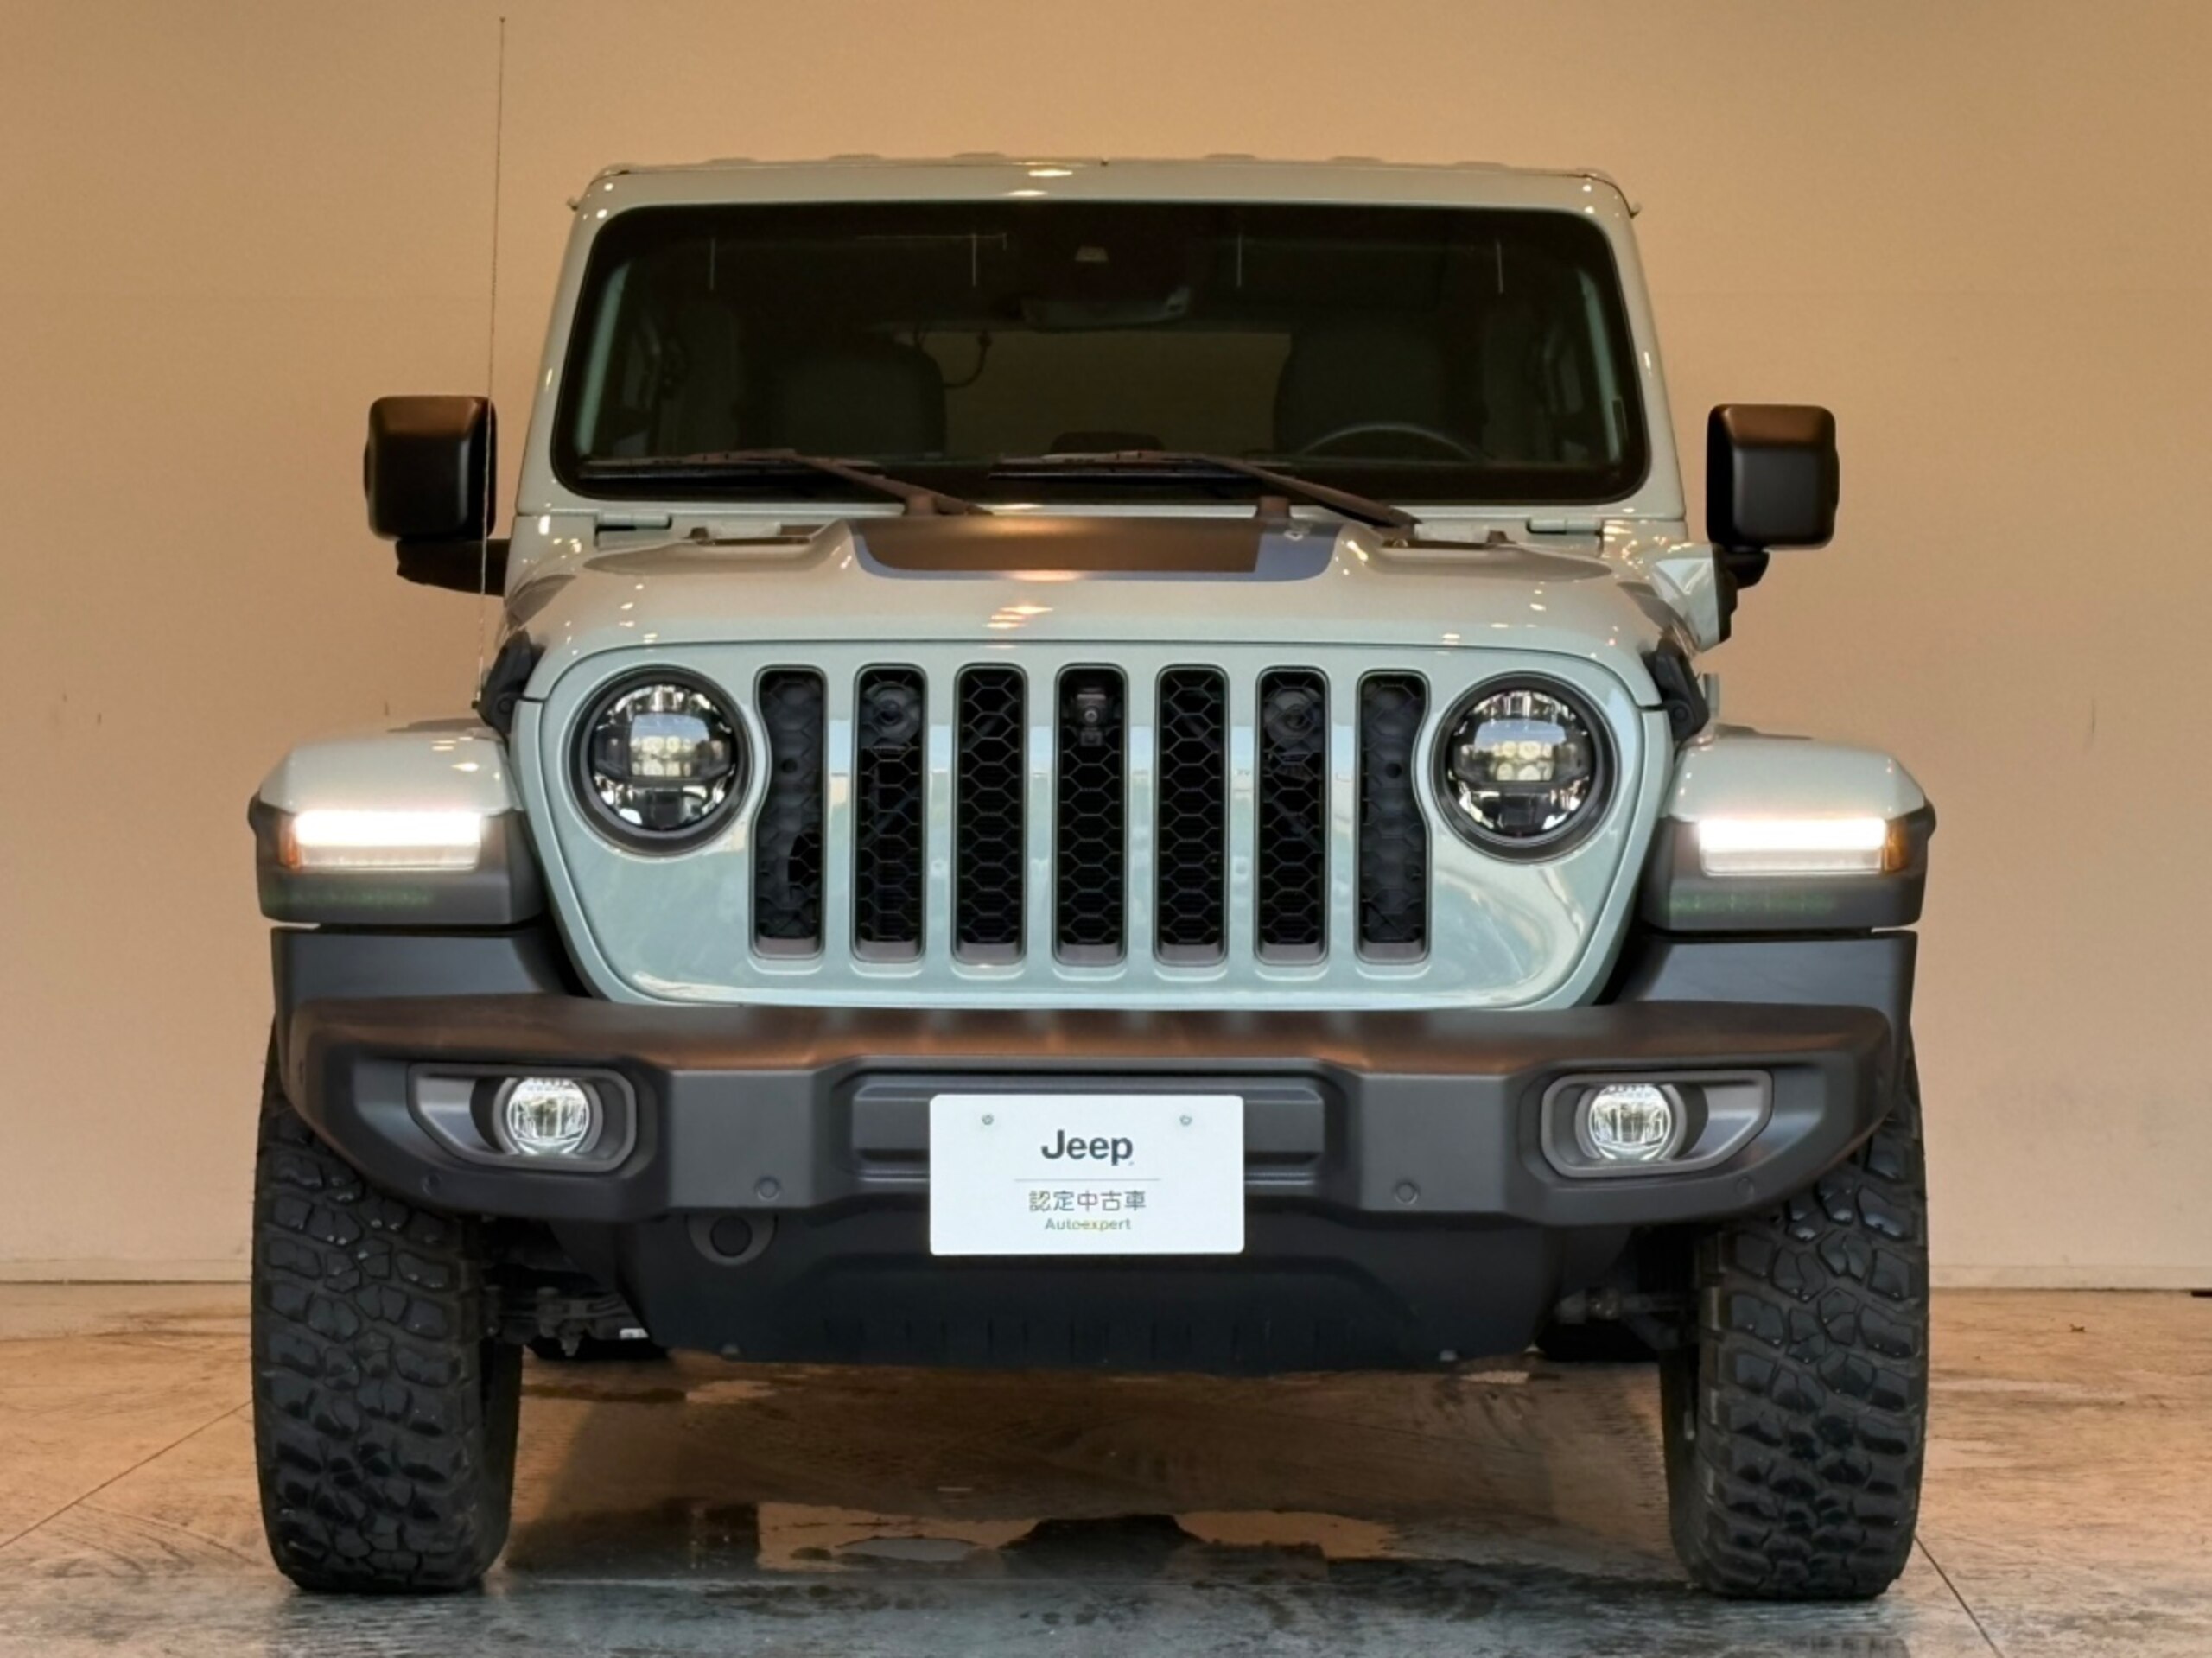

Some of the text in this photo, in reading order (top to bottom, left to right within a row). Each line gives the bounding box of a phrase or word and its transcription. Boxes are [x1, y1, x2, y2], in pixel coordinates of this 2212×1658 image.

[1040, 1129, 1134, 1166] Jeep
[1029, 1190, 1146, 1212] 認定中古車
[1045, 1218, 1131, 1231] Autoexpert
